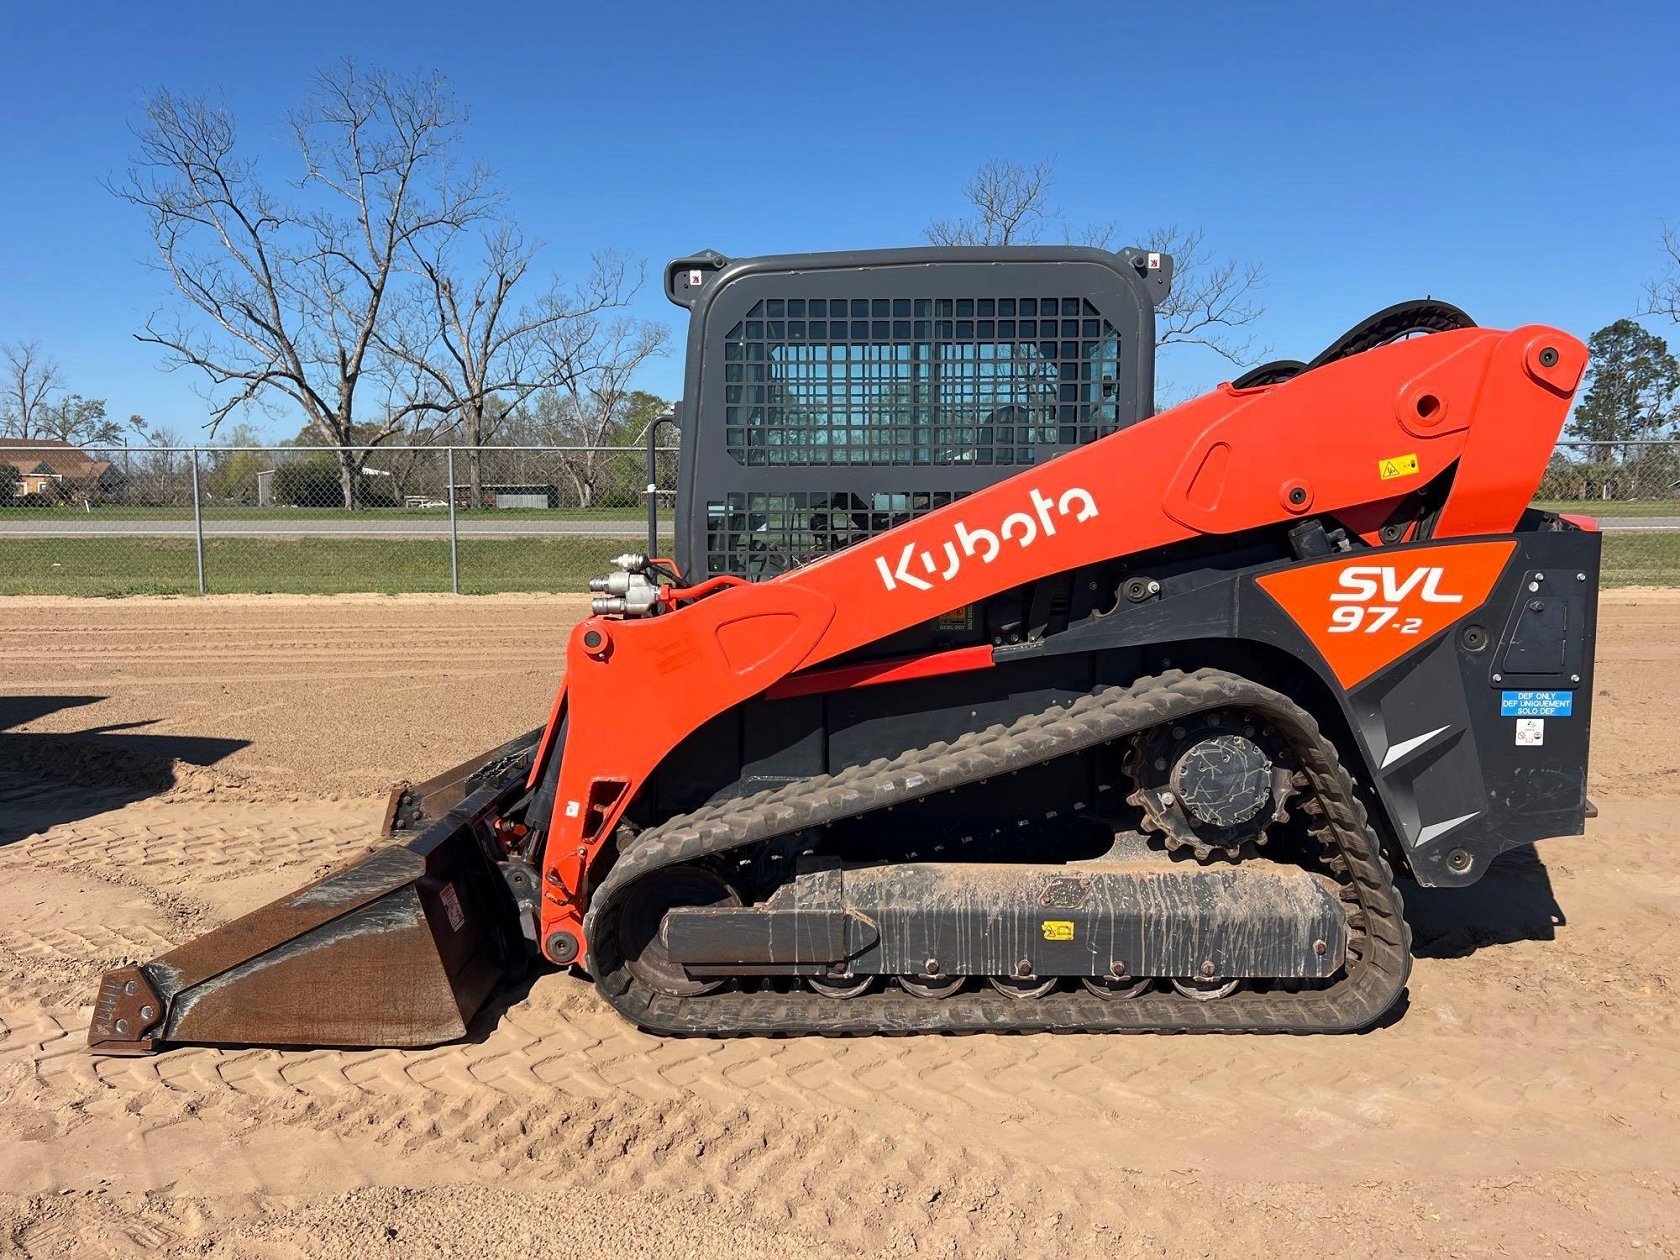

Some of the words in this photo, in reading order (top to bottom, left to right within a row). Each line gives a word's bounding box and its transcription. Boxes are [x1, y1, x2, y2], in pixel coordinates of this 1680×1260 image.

[875, 488, 1099, 591] Kubota
[1329, 566, 1464, 603] SVL
[1327, 605, 1423, 634] 97-2
[1517, 692, 1533, 700] DEF
[1535, 692, 1556, 700] ONLY
[1520, 700, 1571, 708] UNIQUEMENT
[1517, 707, 1537, 715] SOLO
[1540, 707, 1556, 715] DEF
